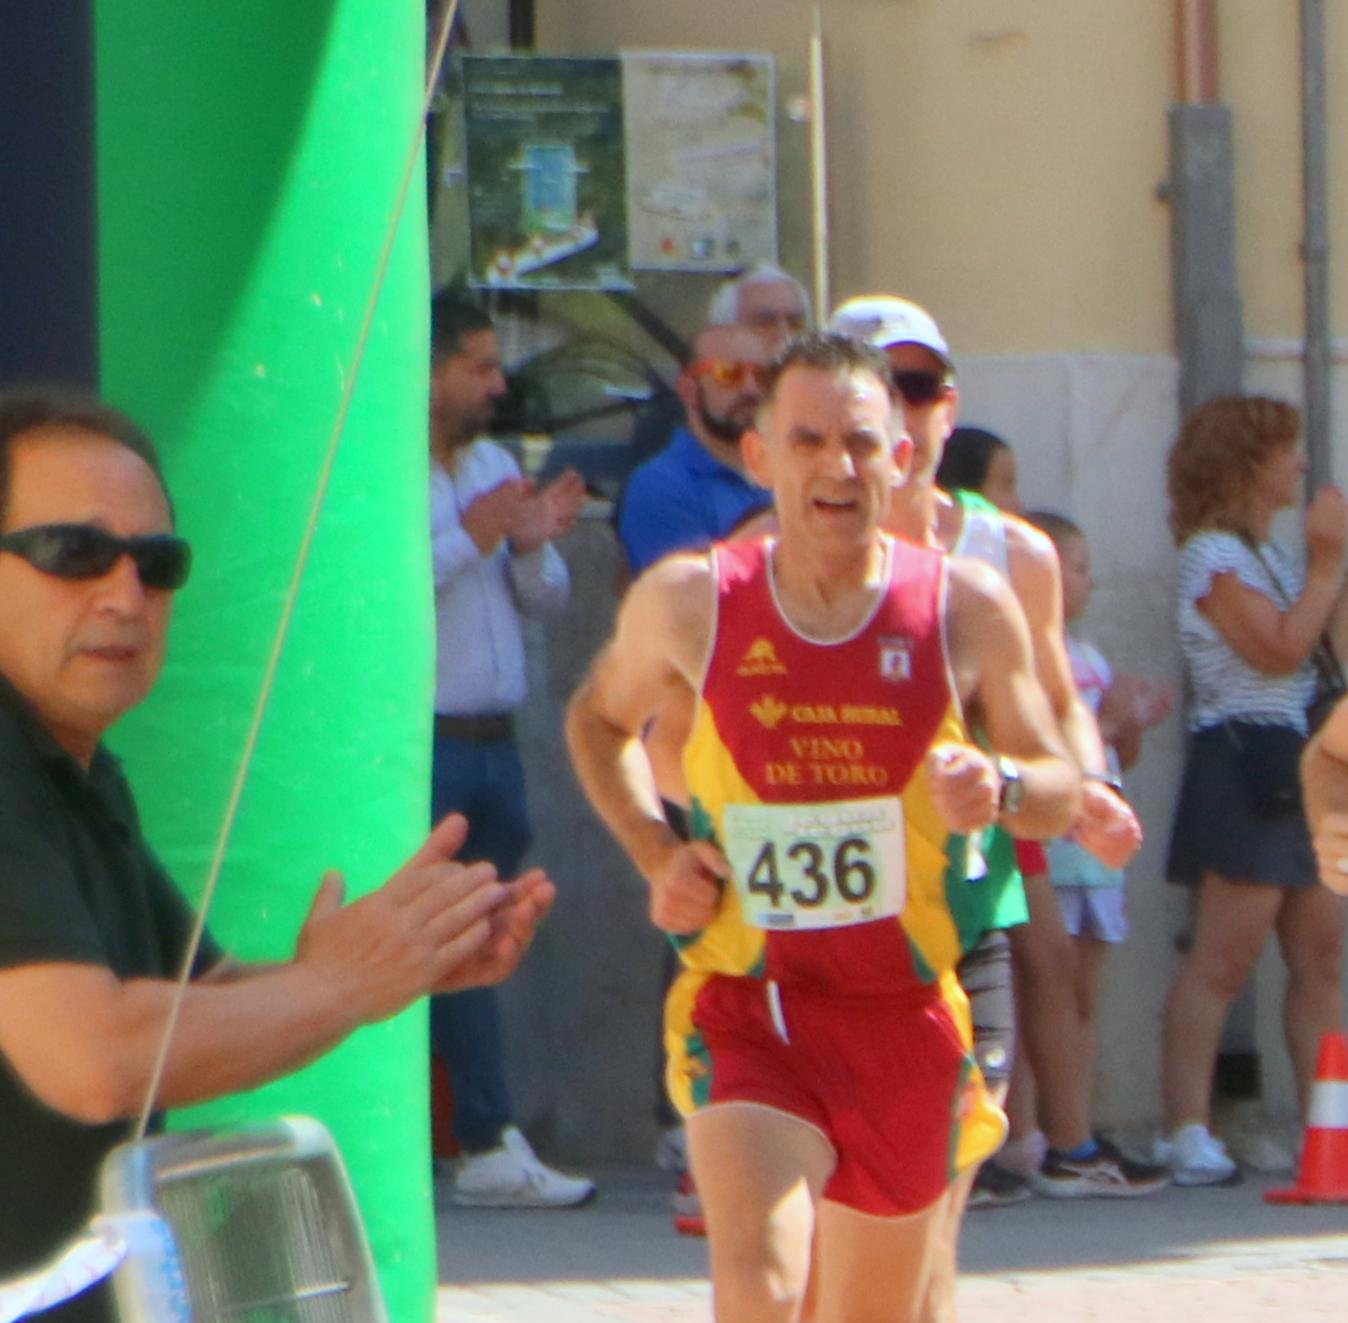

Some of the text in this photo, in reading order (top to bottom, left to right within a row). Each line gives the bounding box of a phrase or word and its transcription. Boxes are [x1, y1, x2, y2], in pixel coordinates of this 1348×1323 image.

[789, 737, 863, 760] VINO
[766, 763, 888, 787] DE TORO
[748, 838, 875, 908] 436
